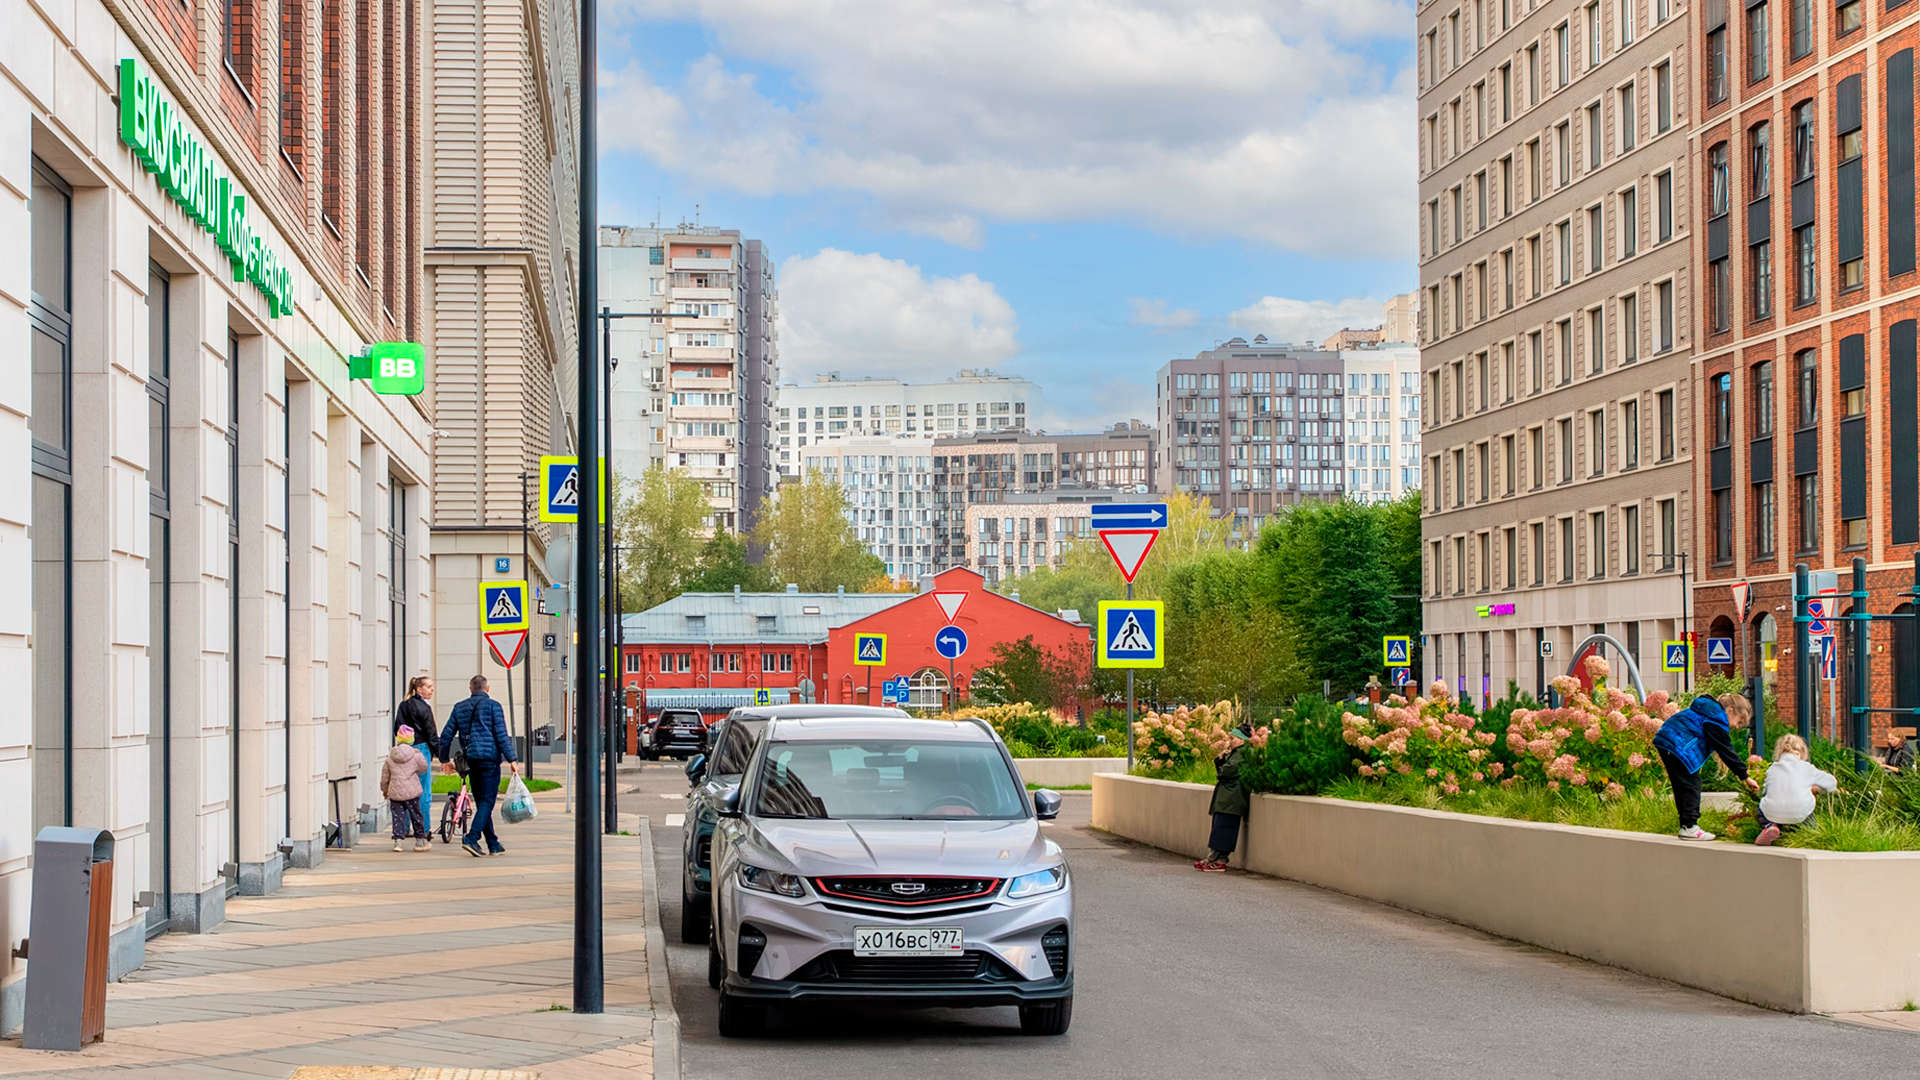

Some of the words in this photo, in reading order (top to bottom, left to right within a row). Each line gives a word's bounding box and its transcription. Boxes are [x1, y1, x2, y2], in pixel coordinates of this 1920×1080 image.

[132, 59, 220, 234] ВКУСВИЛЛ
[499, 560, 507, 568] 16
[547, 636, 554, 645] 9
[1544, 644, 1550, 652] 4
[885, 683, 894, 695] P
[899, 691, 907, 701] P
[931, 930, 957, 944] 977
